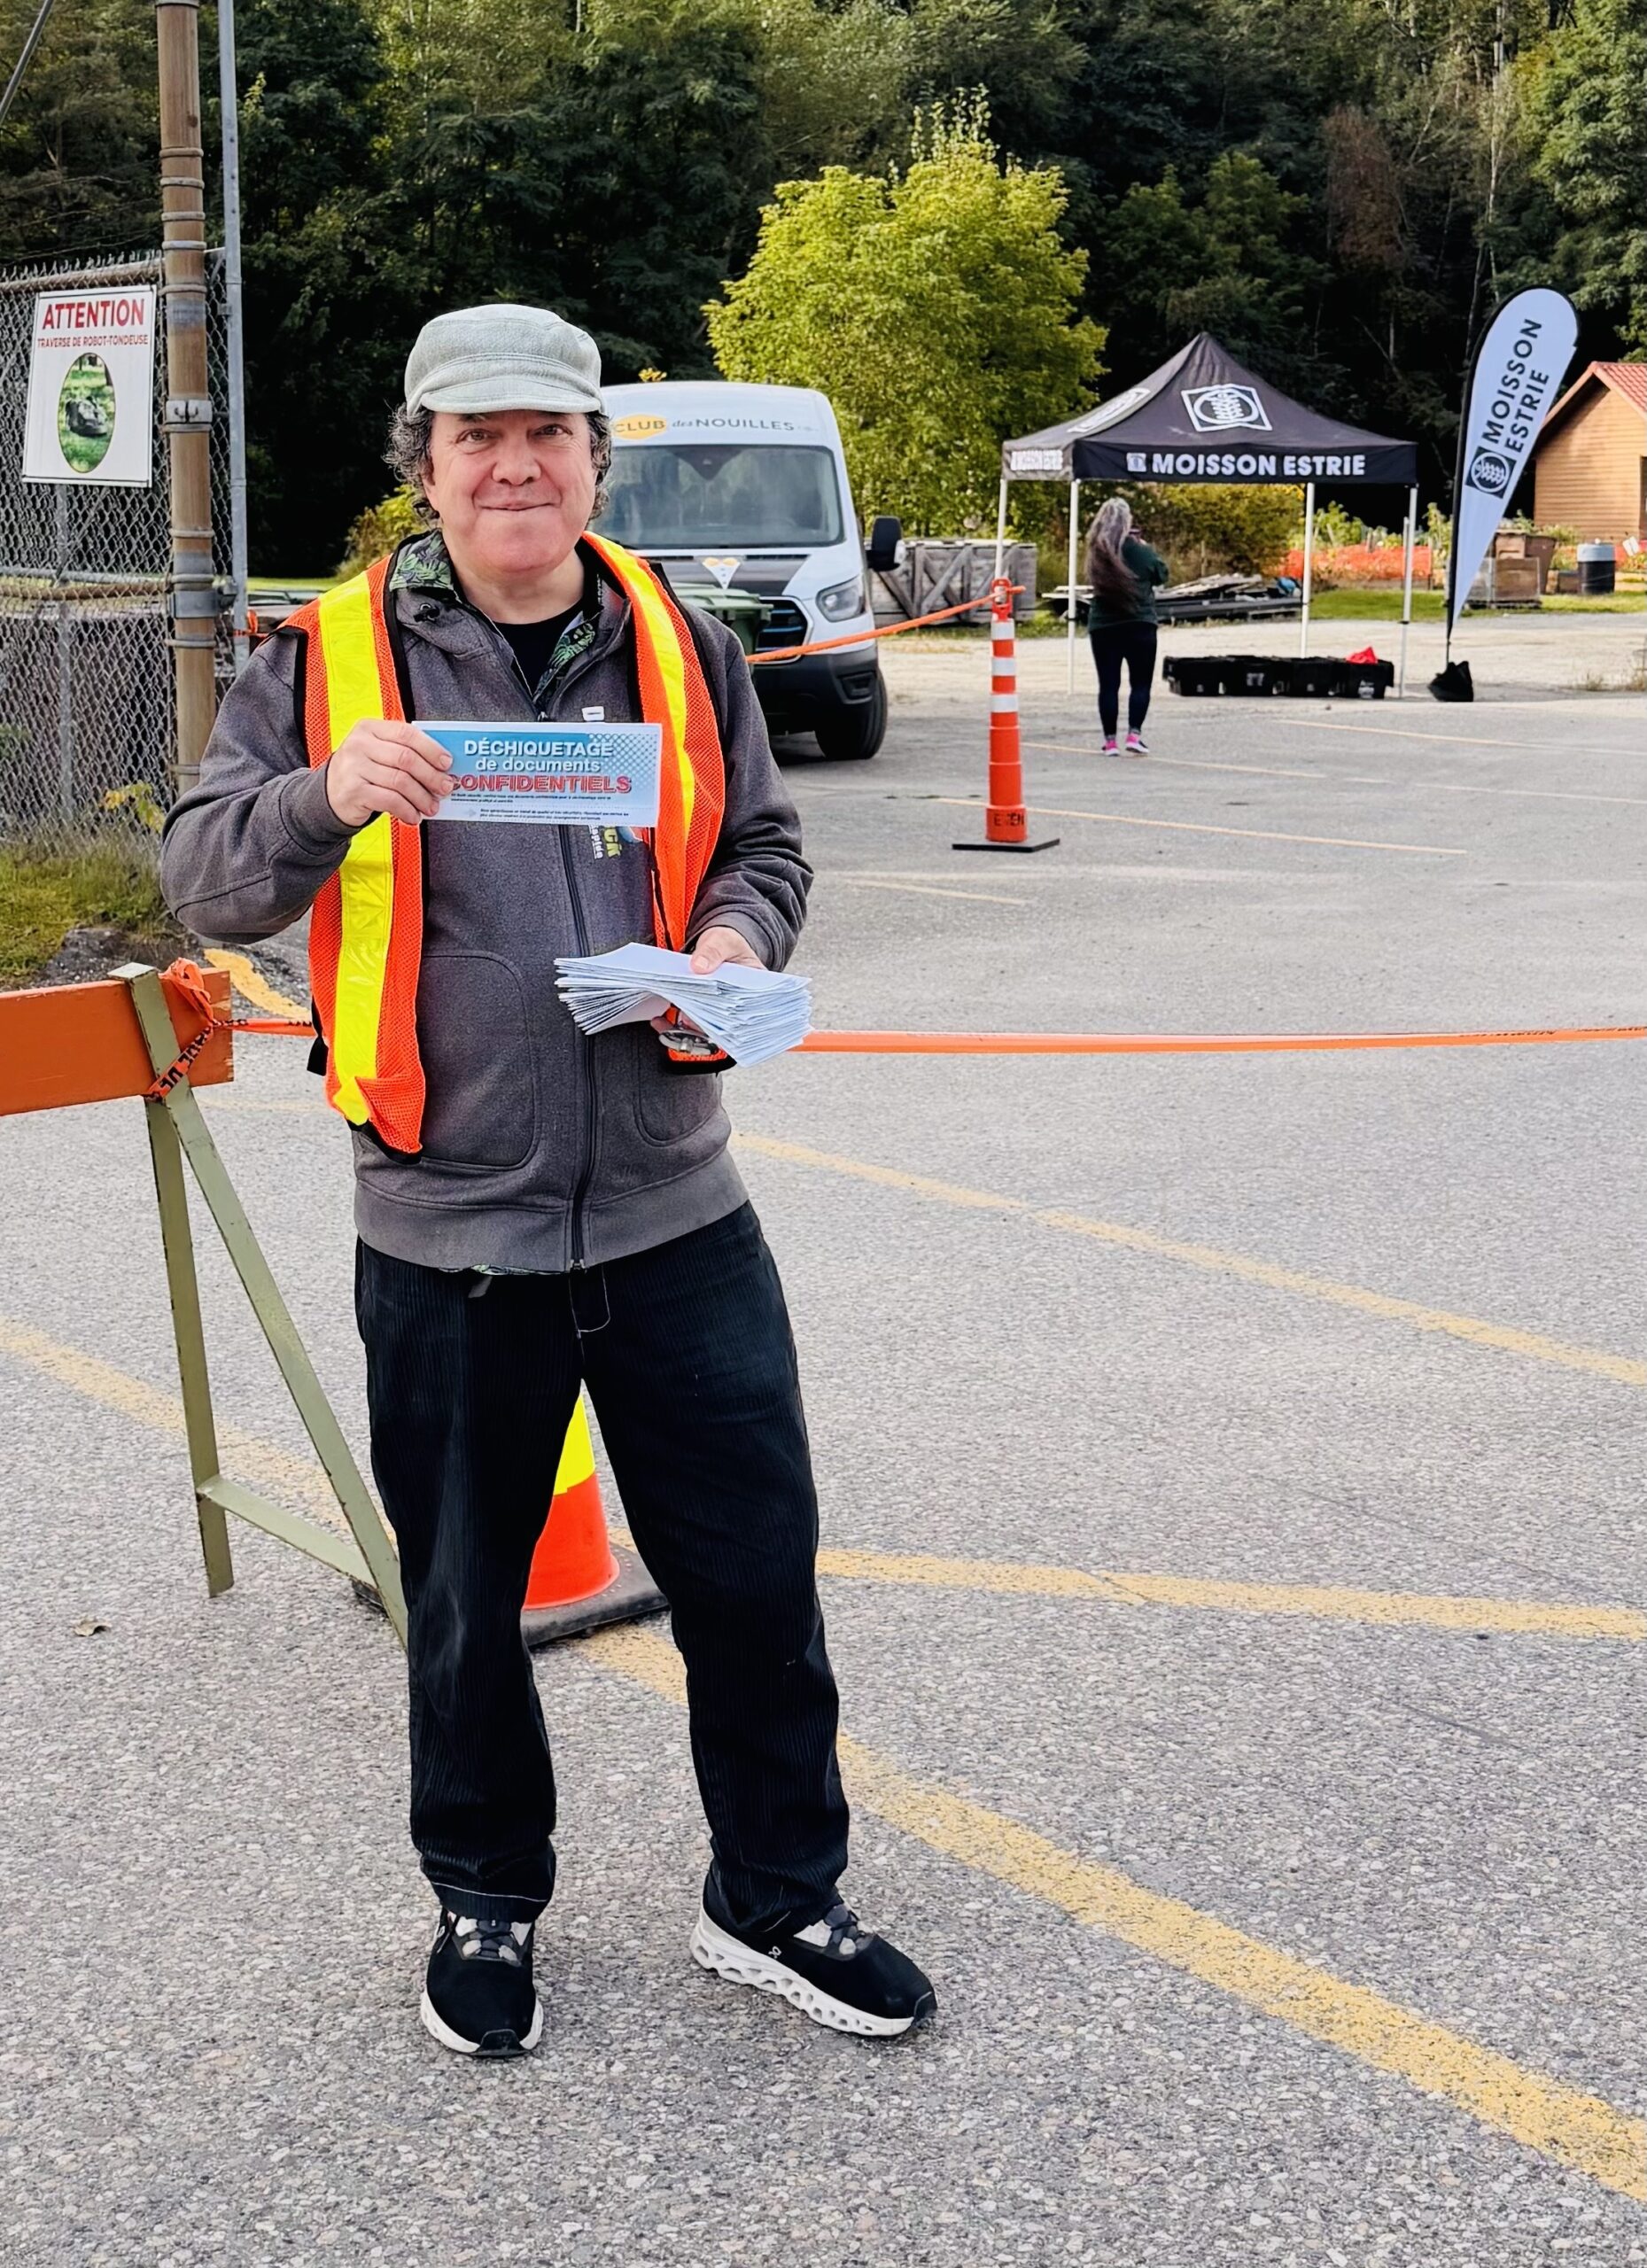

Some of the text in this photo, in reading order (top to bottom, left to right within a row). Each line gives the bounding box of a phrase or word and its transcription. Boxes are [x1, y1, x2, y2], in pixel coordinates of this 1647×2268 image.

[42, 299, 145, 330] ATTENTION
[37, 334, 149, 348] TRAVERSE DE ROBOT-TONDEUSE
[1481, 318, 1542, 444] MOISSON
[1504, 369, 1550, 453] ESTRIE
[614, 420, 665, 433] CLUB
[695, 417, 795, 431] NOUILLES
[1152, 453, 1366, 476] MOISSON ESTRIE
[464, 737, 614, 757] DÉCHIQUETAGE
[475, 757, 601, 773] de documents
